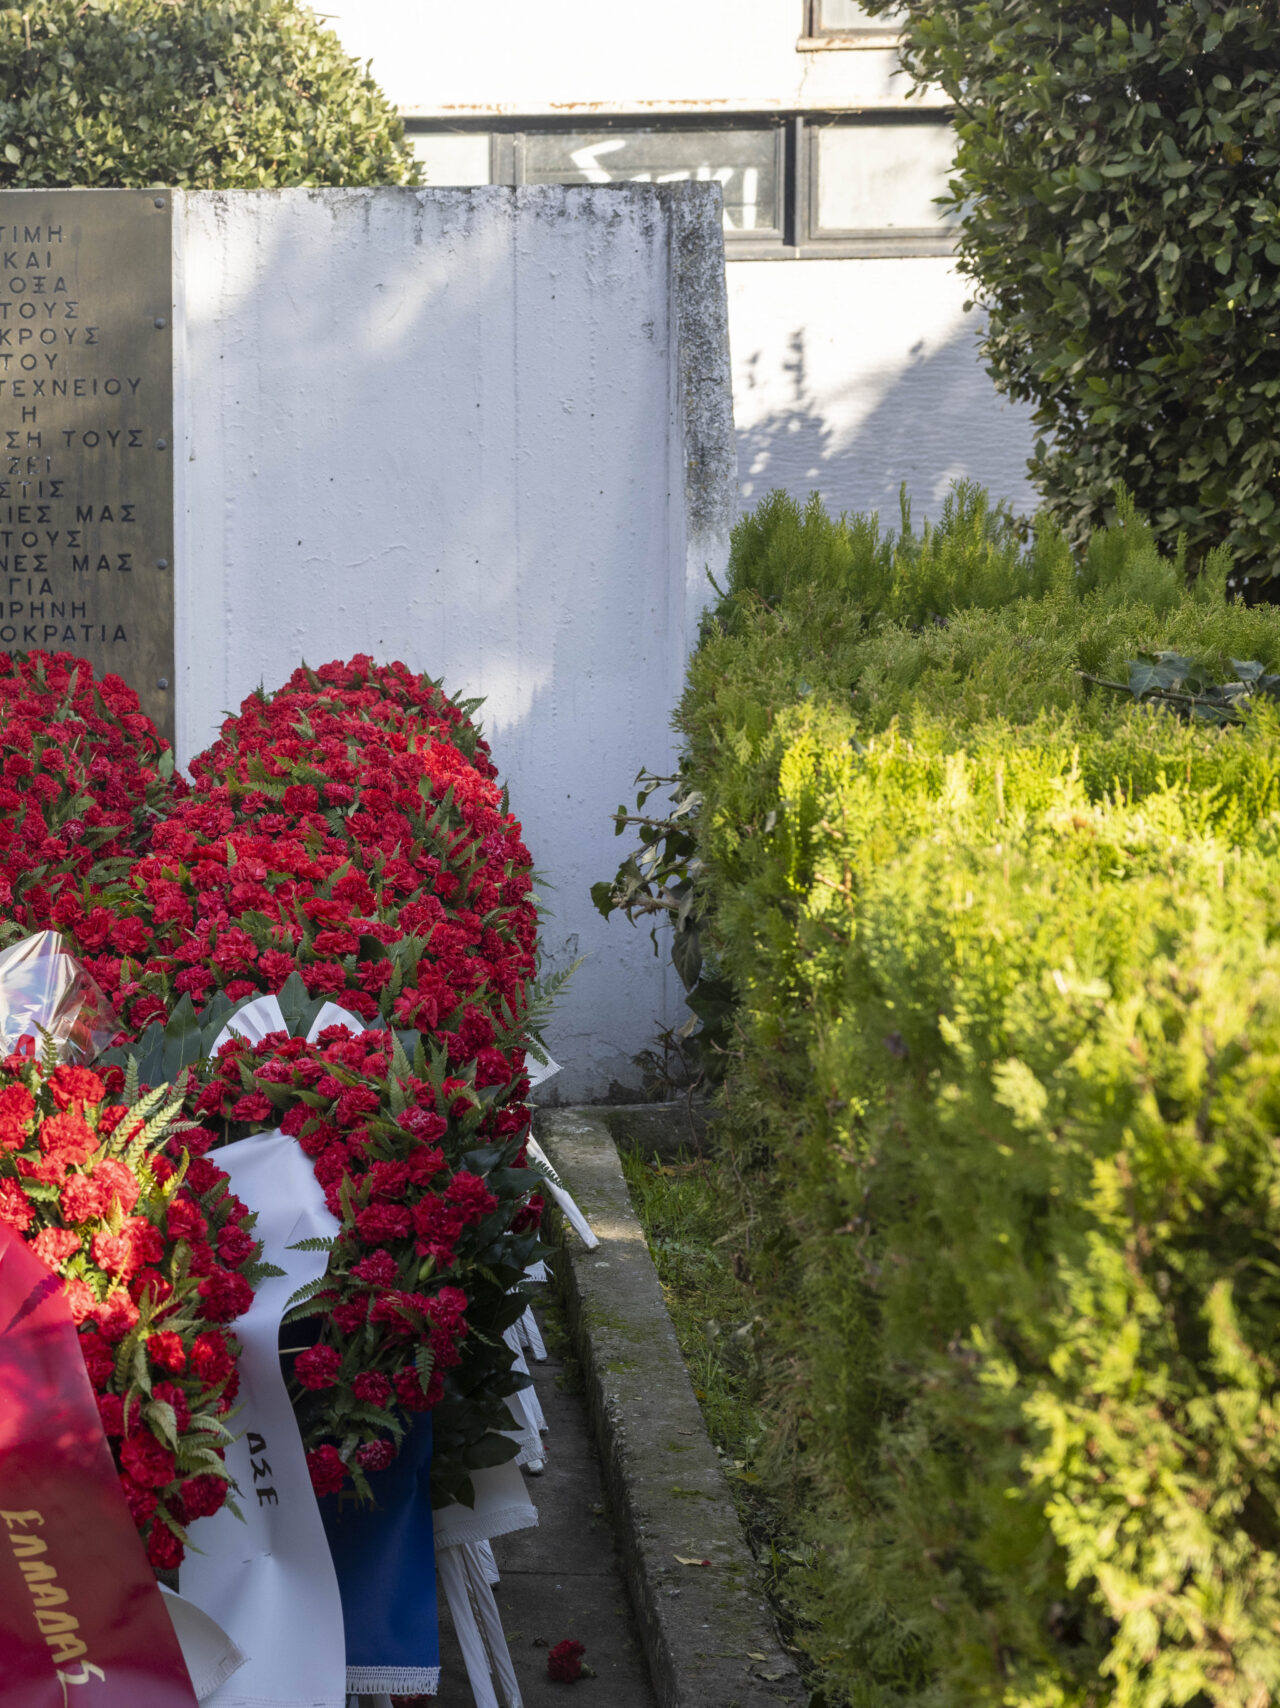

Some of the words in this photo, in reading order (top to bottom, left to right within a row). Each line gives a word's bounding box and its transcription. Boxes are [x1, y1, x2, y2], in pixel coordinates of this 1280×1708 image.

[3, 251, 52, 270] ΚΑΙ
[0, 353, 59, 371] ΤΟΥ
[21, 405, 37, 423] Η
[61, 429, 144, 448] ΤΟΥΣ
[7, 456, 52, 475] ΖΕΙ
[75, 504, 136, 523] ΜΑΣ
[72, 553, 133, 572] ΜΑΣ
[8, 577, 54, 596] ΓΙΑ
